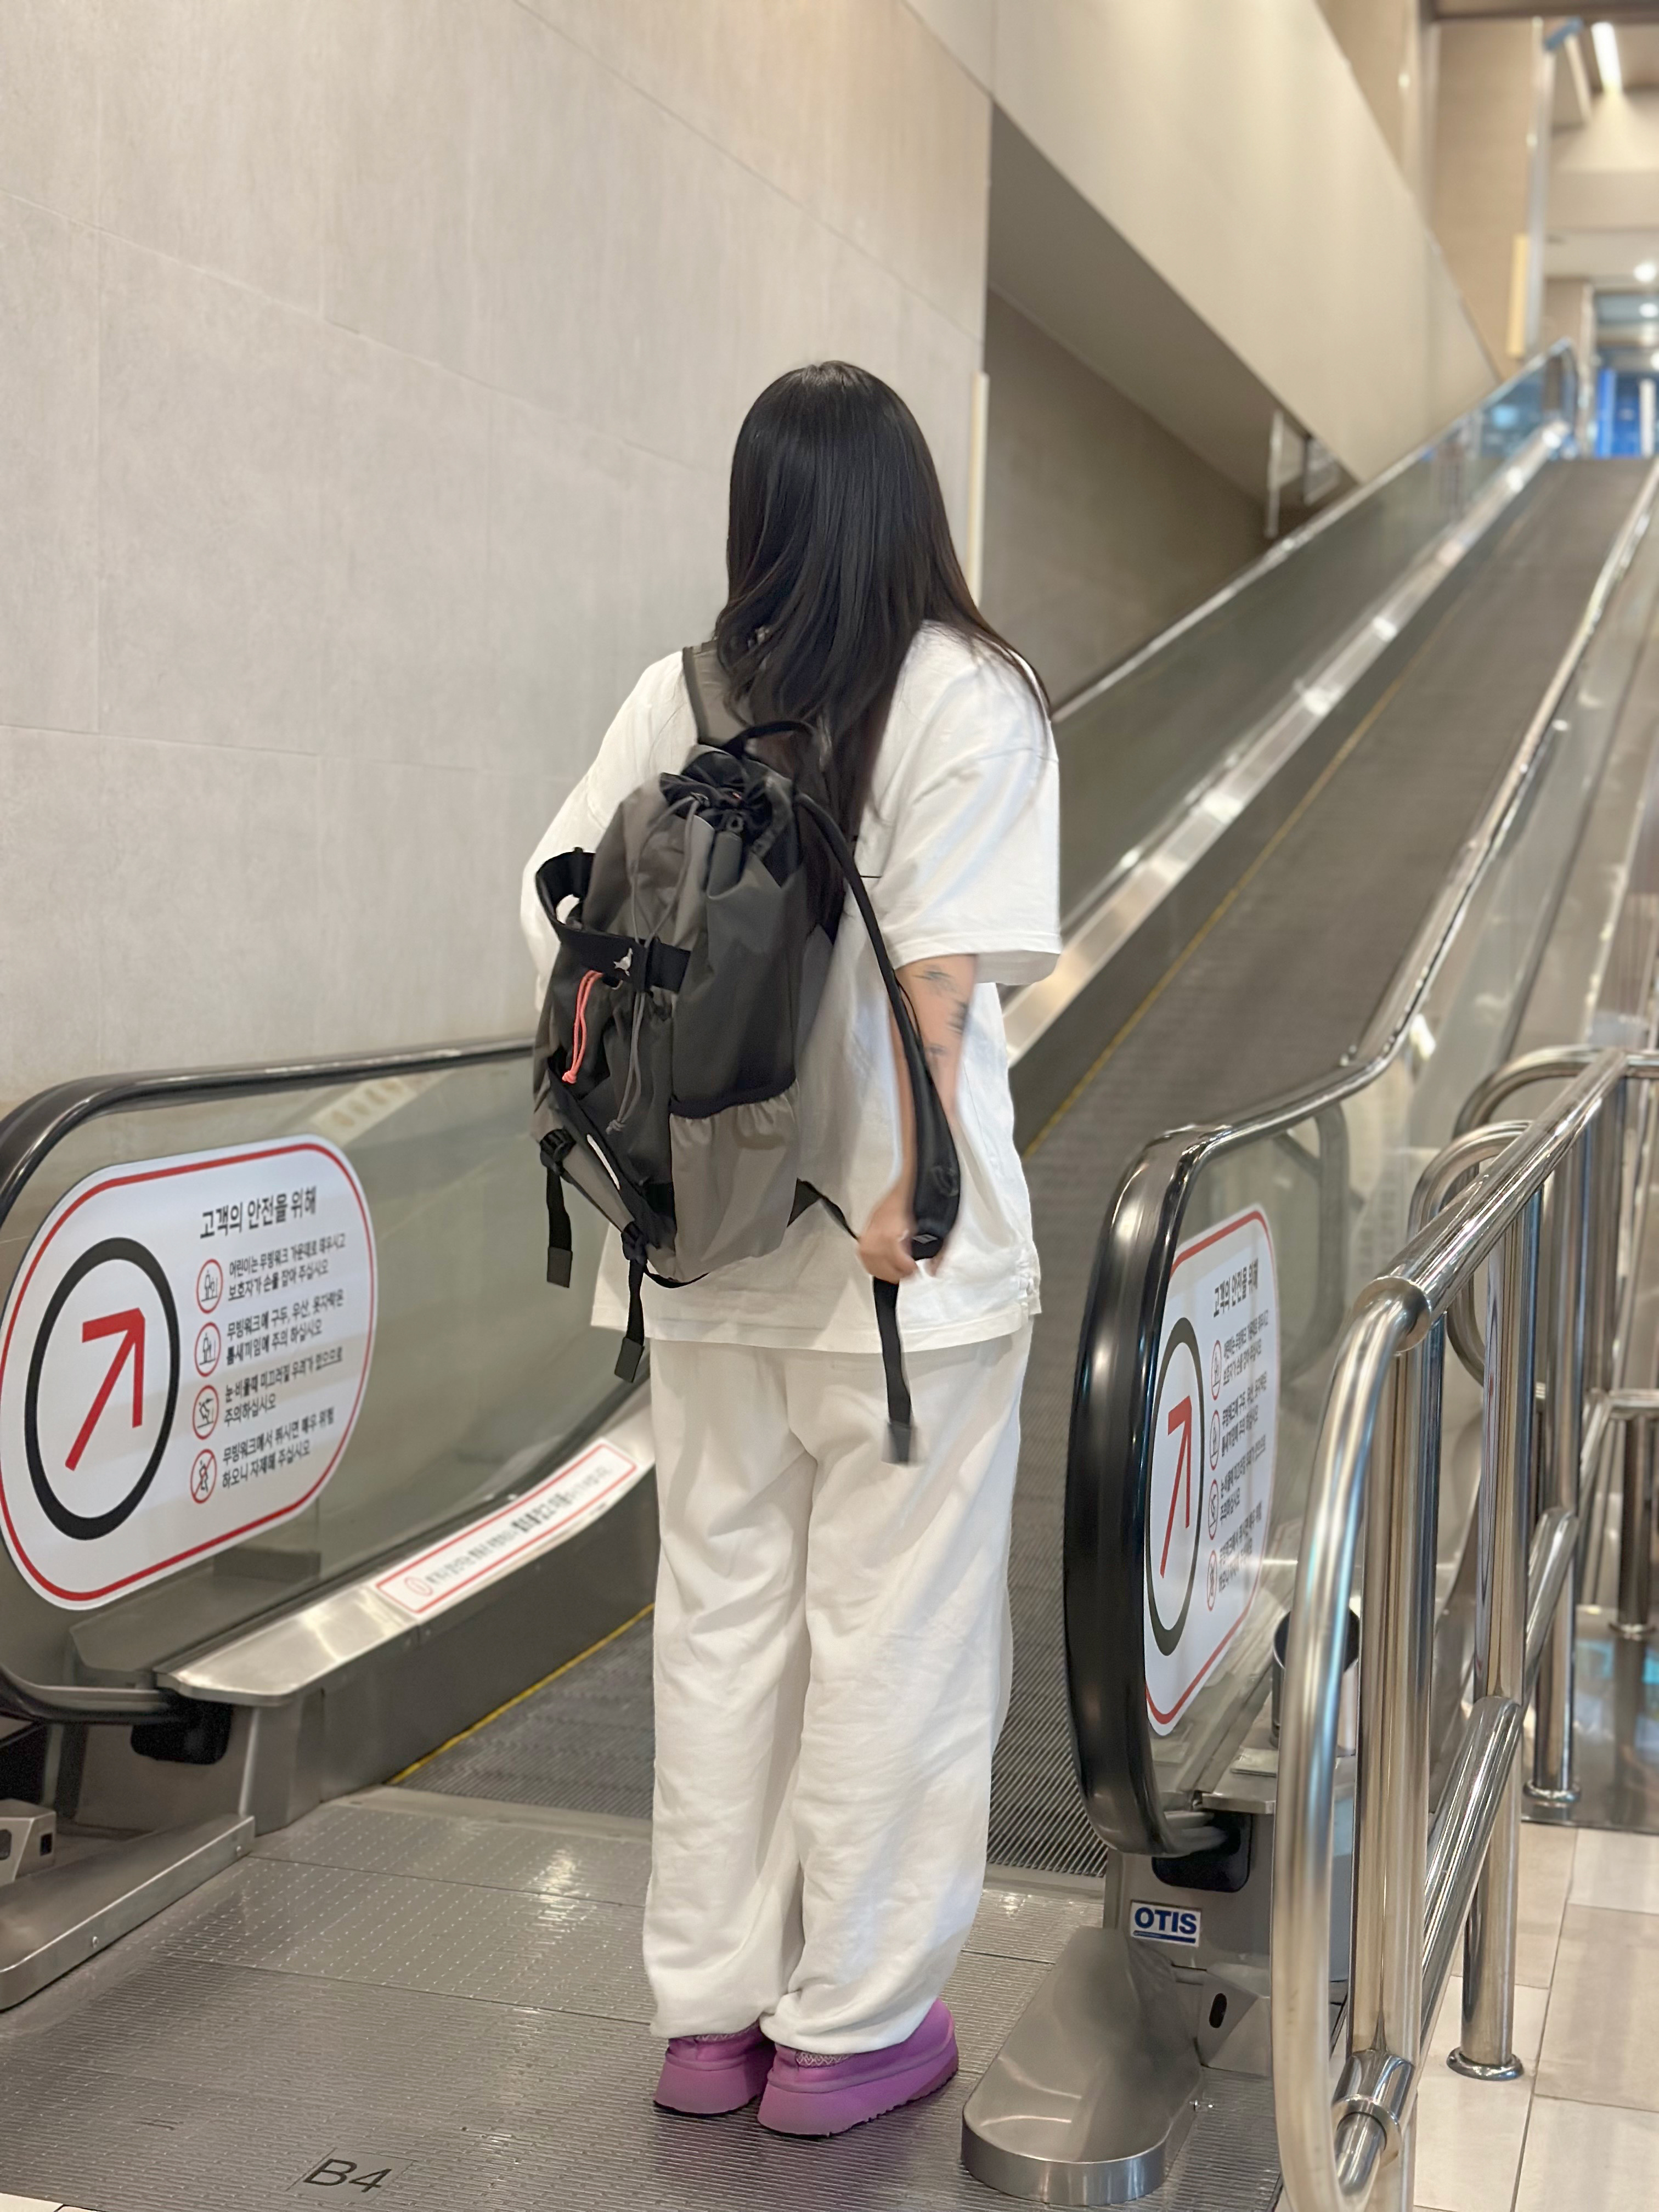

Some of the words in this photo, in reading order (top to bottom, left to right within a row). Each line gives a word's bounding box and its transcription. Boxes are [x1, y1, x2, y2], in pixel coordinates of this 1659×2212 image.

[200, 1201, 243, 1239] 고객의
[248, 1193, 287, 1229] 안전을
[291, 1186, 317, 1219] 위해
[228, 1277, 262, 1301] 보호자가
[263, 1272, 279, 1292] 손을
[281, 1267, 297, 1288] 잡아
[298, 1259, 329, 1281] 주십시오
[229, 1255, 258, 1278] 어린이는
[260, 1248, 289, 1269] 무빙워크
[1213, 1277, 1230, 1318] 고객의
[1232, 1267, 1247, 1306] 안전을
[227, 1311, 269, 1341] 무빙워크에
[271, 1306, 290, 1327] 구두,
[272, 1328, 287, 1350] 주의
[290, 1319, 323, 1342] 하십시오
[224, 1393, 276, 1427] 주의하십시오
[222, 1429, 273, 1465] 무빙워크에서
[222, 1467, 249, 1489] 하오니
[278, 1439, 311, 1466] 주십시오
[1135, 1907, 1197, 1935] OTIS
[303, 2158, 392, 2193] B4
